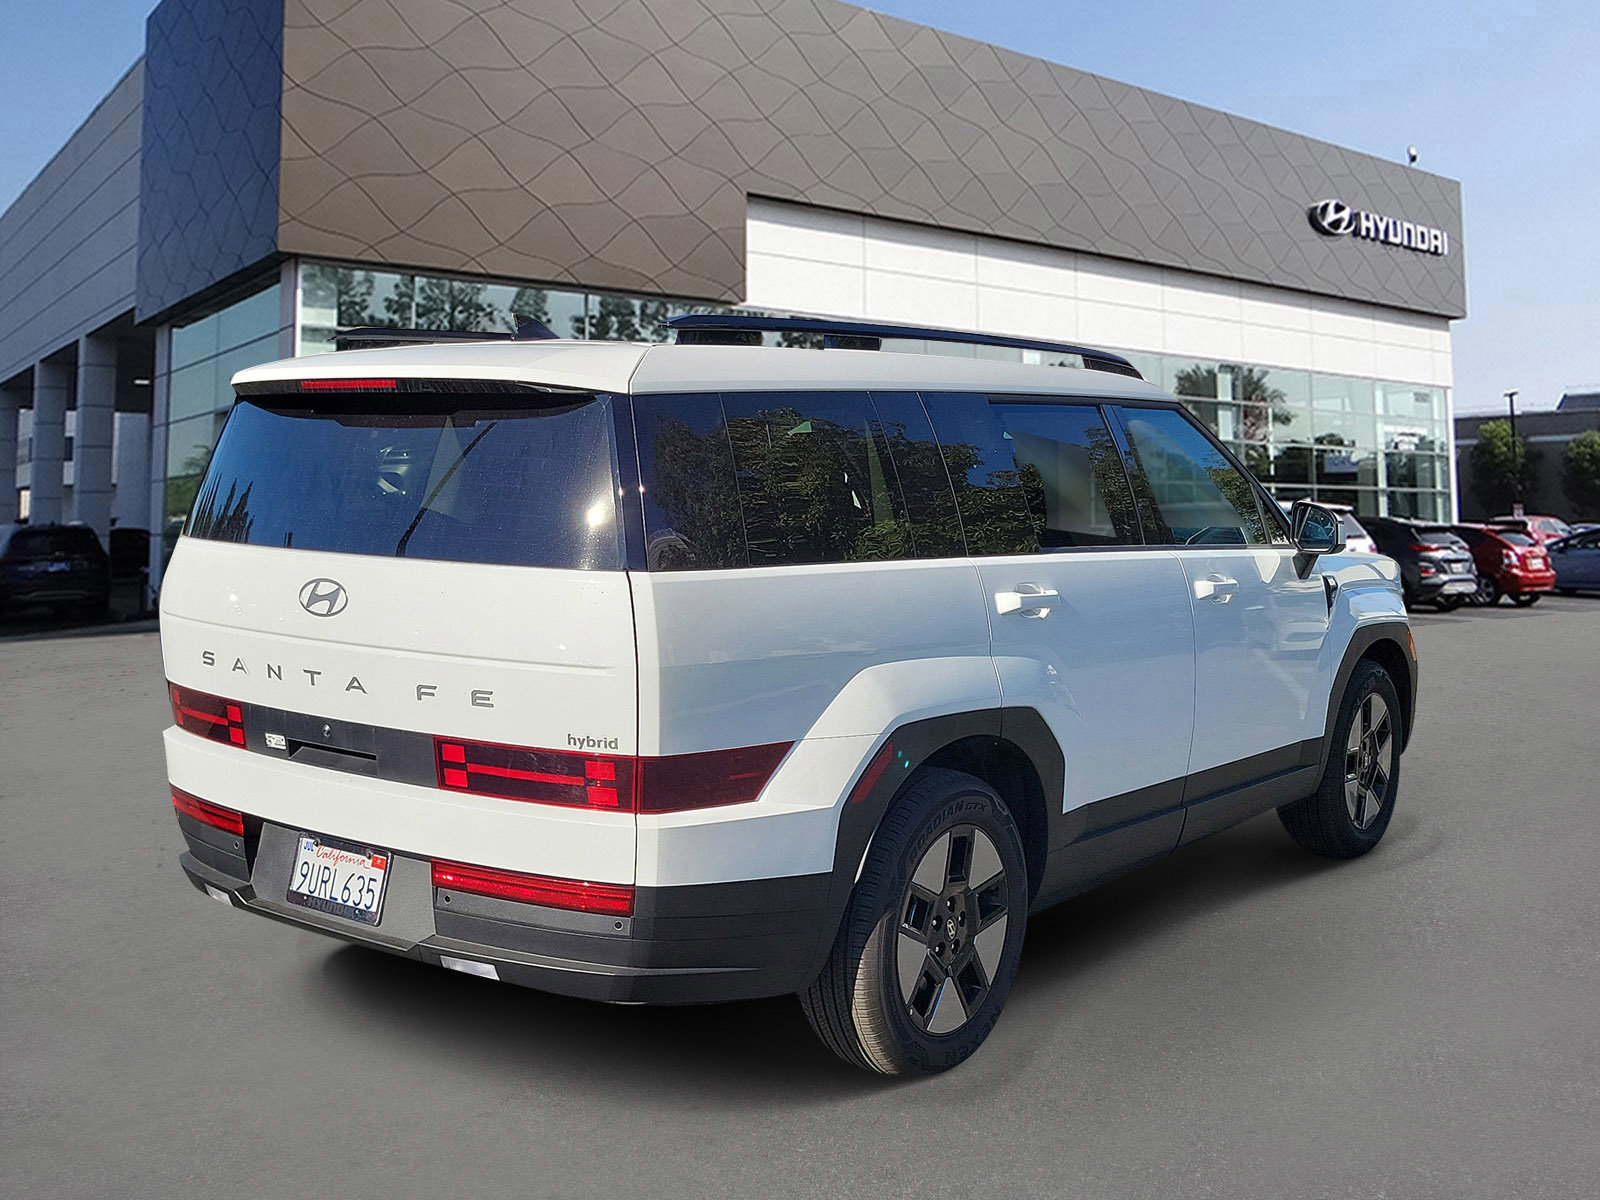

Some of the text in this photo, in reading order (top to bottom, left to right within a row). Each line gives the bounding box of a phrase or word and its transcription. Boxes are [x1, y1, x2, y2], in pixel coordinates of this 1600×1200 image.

[1360, 211, 1448, 255] HYUNDAI
[202, 650, 495, 709] SANTA FE
[567, 733, 619, 750] hybrid
[315, 845, 371, 870] California
[296, 861, 377, 910] 9URL635
